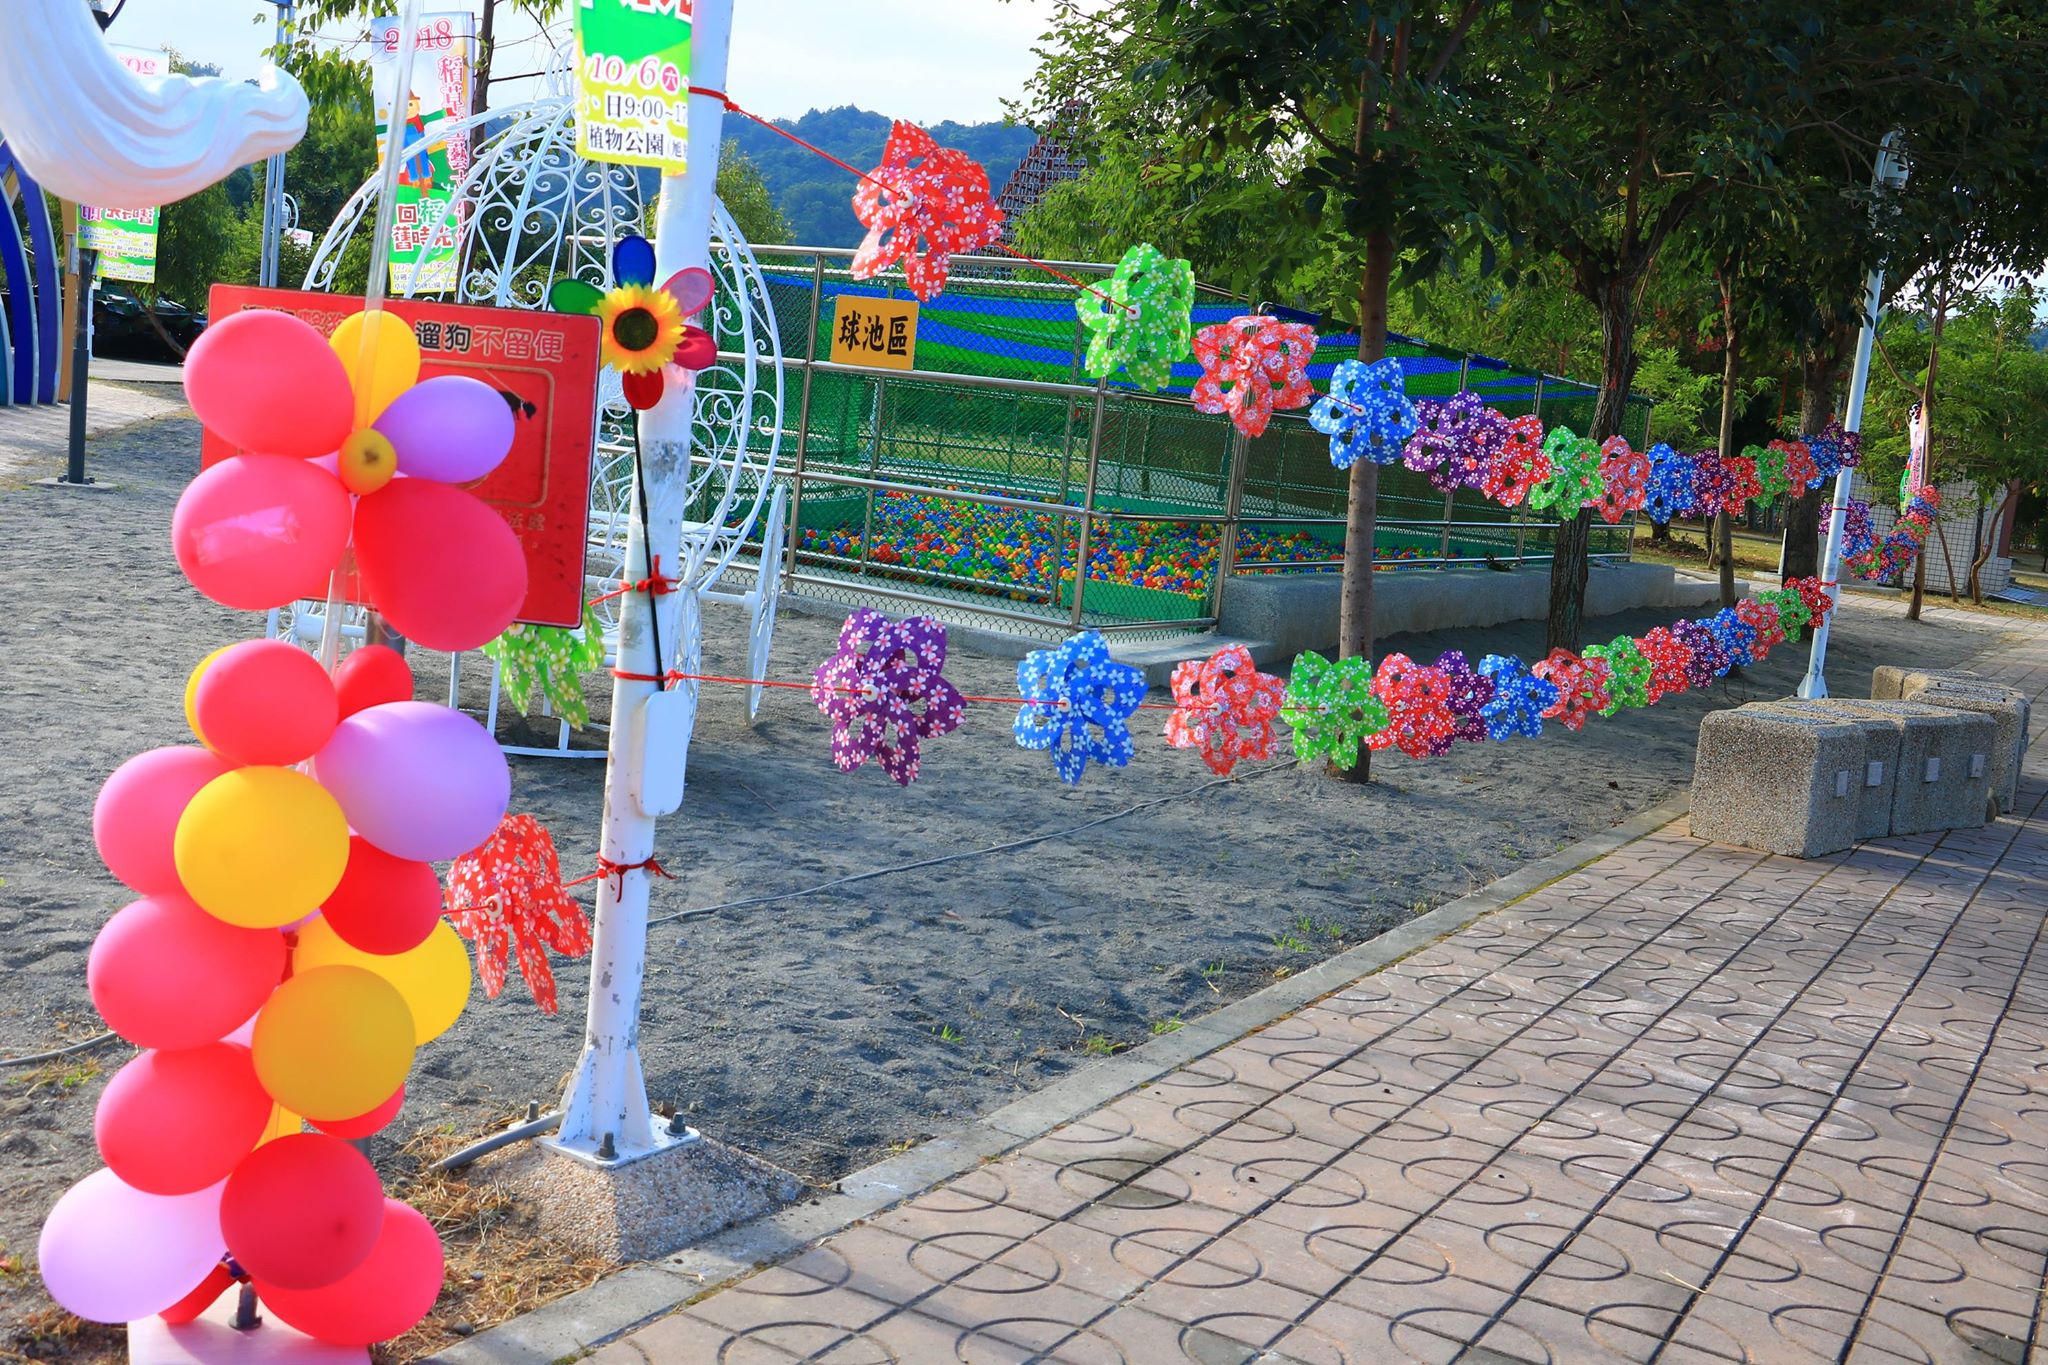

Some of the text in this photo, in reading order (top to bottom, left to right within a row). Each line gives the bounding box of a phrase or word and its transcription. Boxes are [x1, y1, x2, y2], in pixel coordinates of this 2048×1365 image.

[414, 320, 566, 363] 遛狗不留便
[838, 309, 909, 356] 球池區
